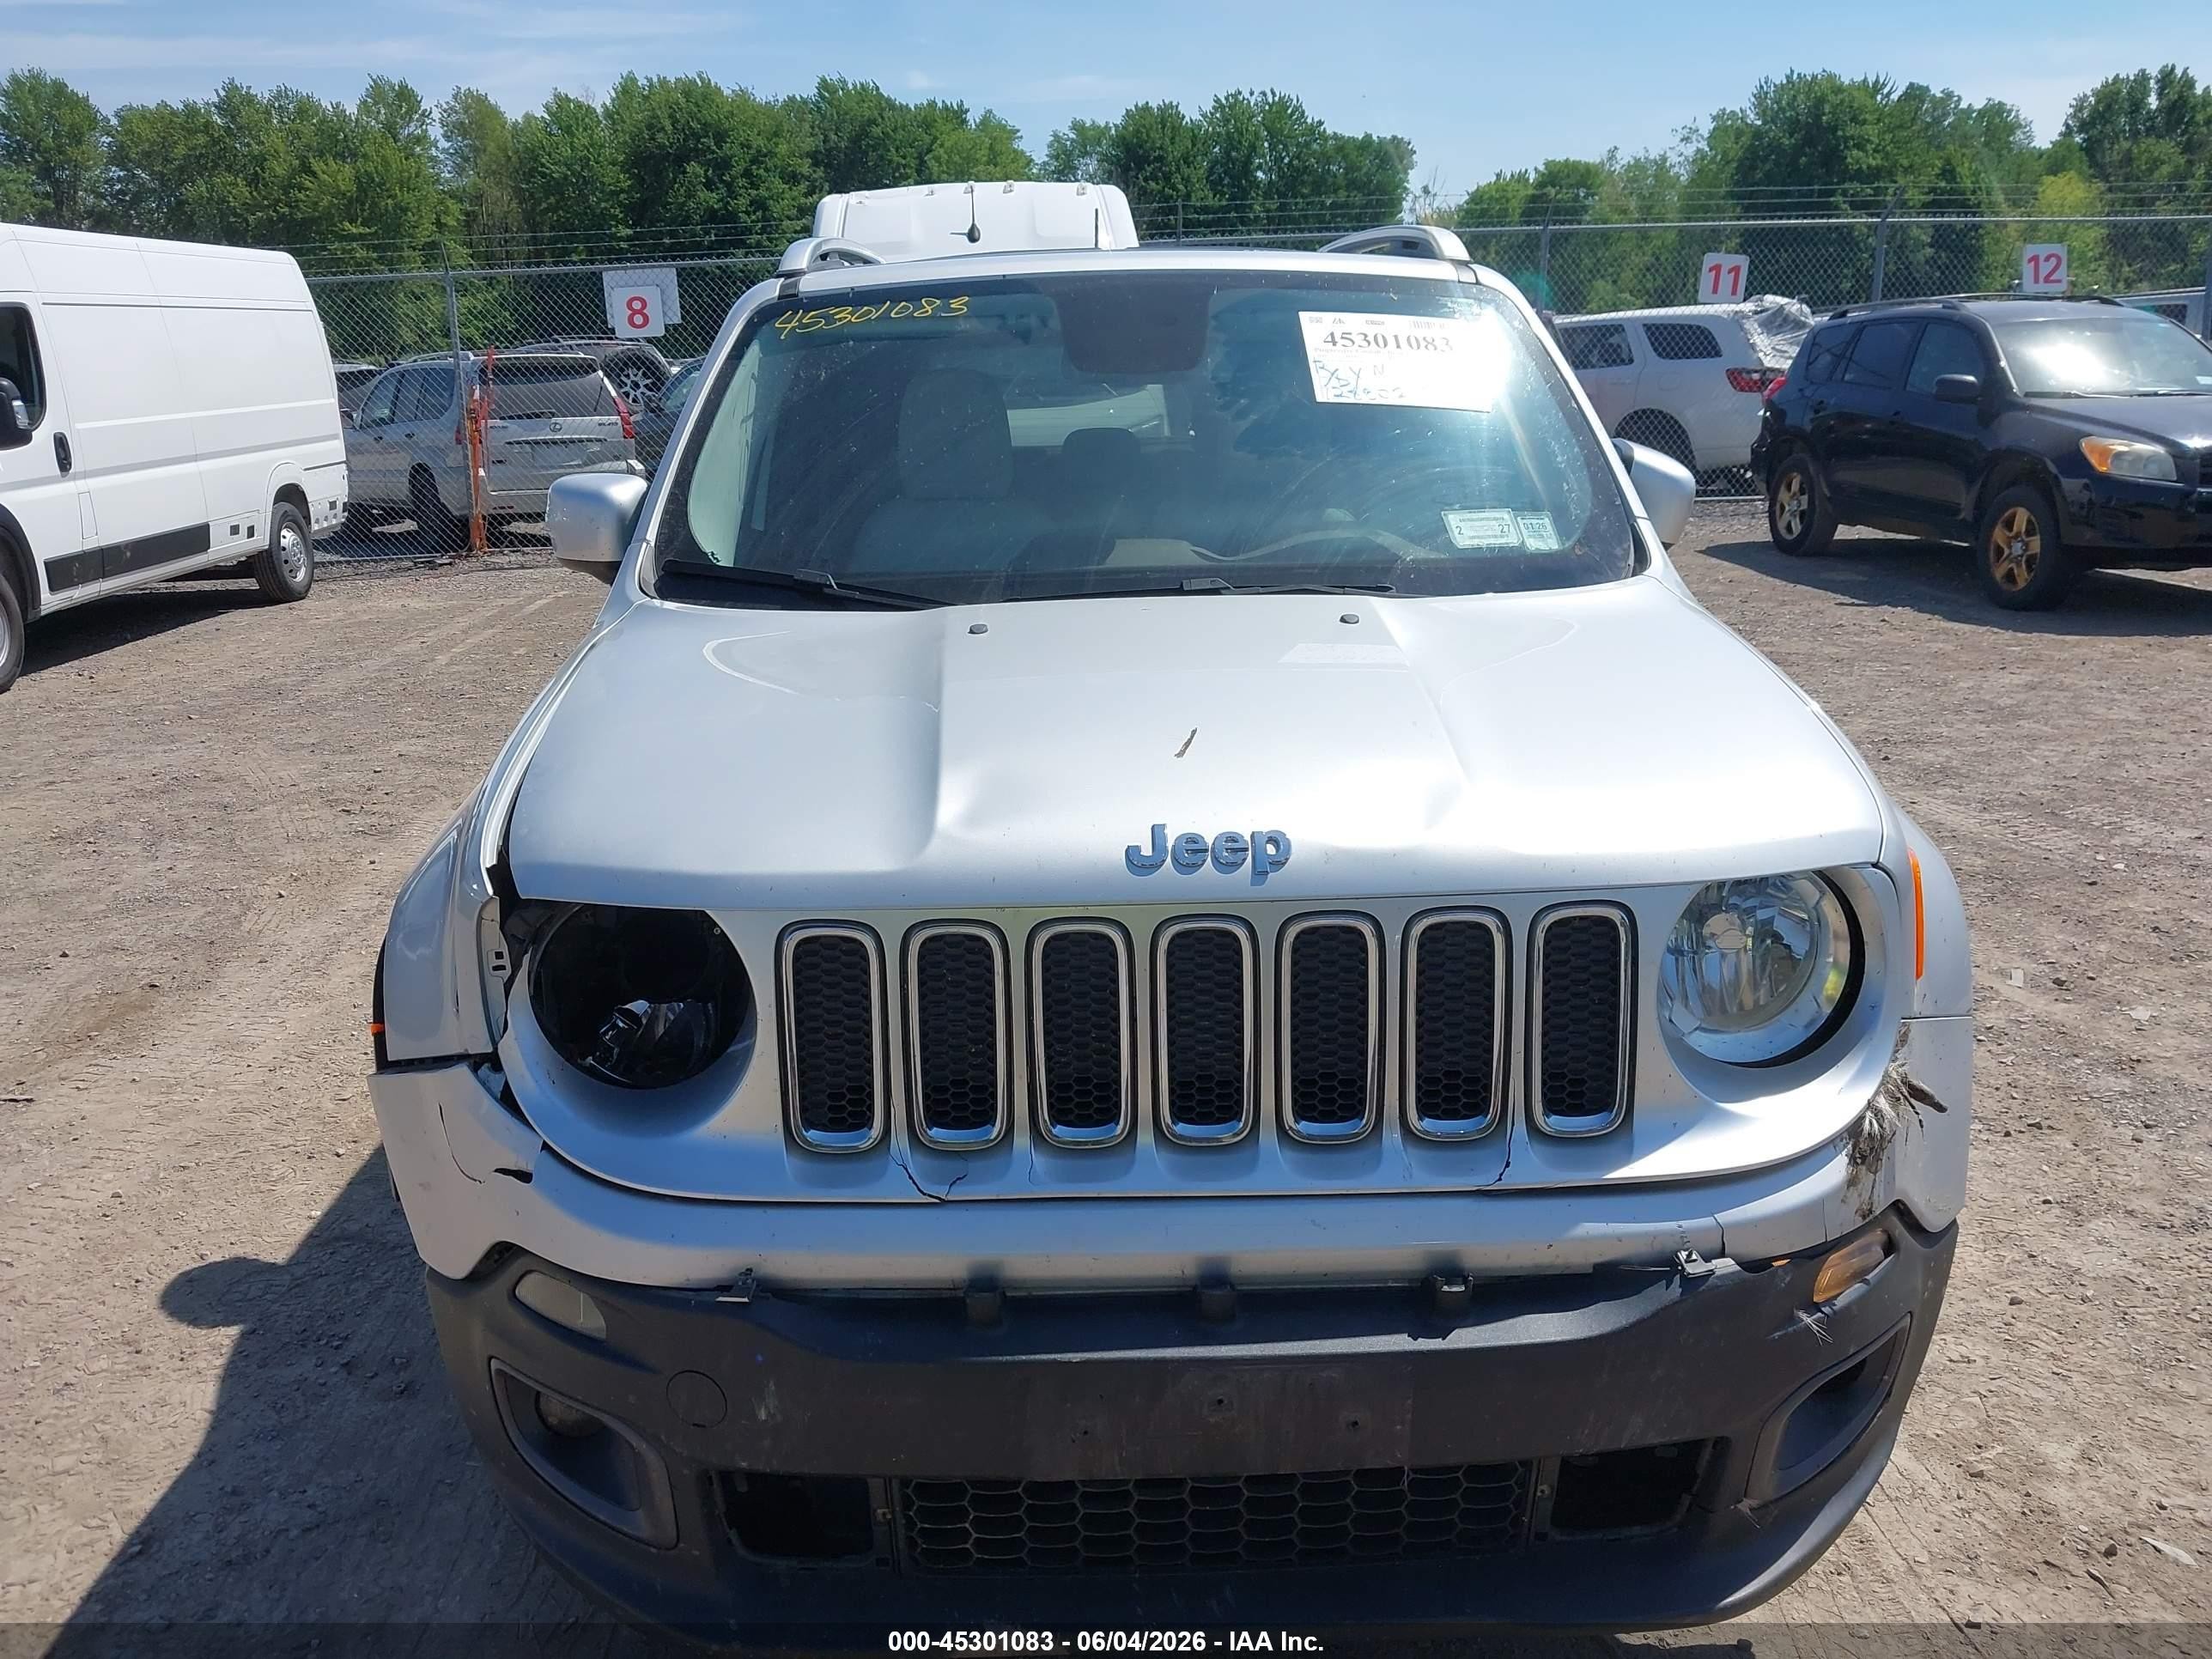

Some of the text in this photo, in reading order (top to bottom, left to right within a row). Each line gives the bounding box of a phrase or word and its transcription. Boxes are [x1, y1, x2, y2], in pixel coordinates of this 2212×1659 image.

[1708, 263, 1741, 296] 11
[2027, 253, 2063, 284] 12
[626, 296, 650, 329] 8
[775, 295, 969, 340] 45301083
[1322, 331, 1453, 352] 45301083
[1455, 525, 1464, 536] 2
[1498, 523, 1510, 534] 27
[1125, 823, 1291, 883] Jeep
